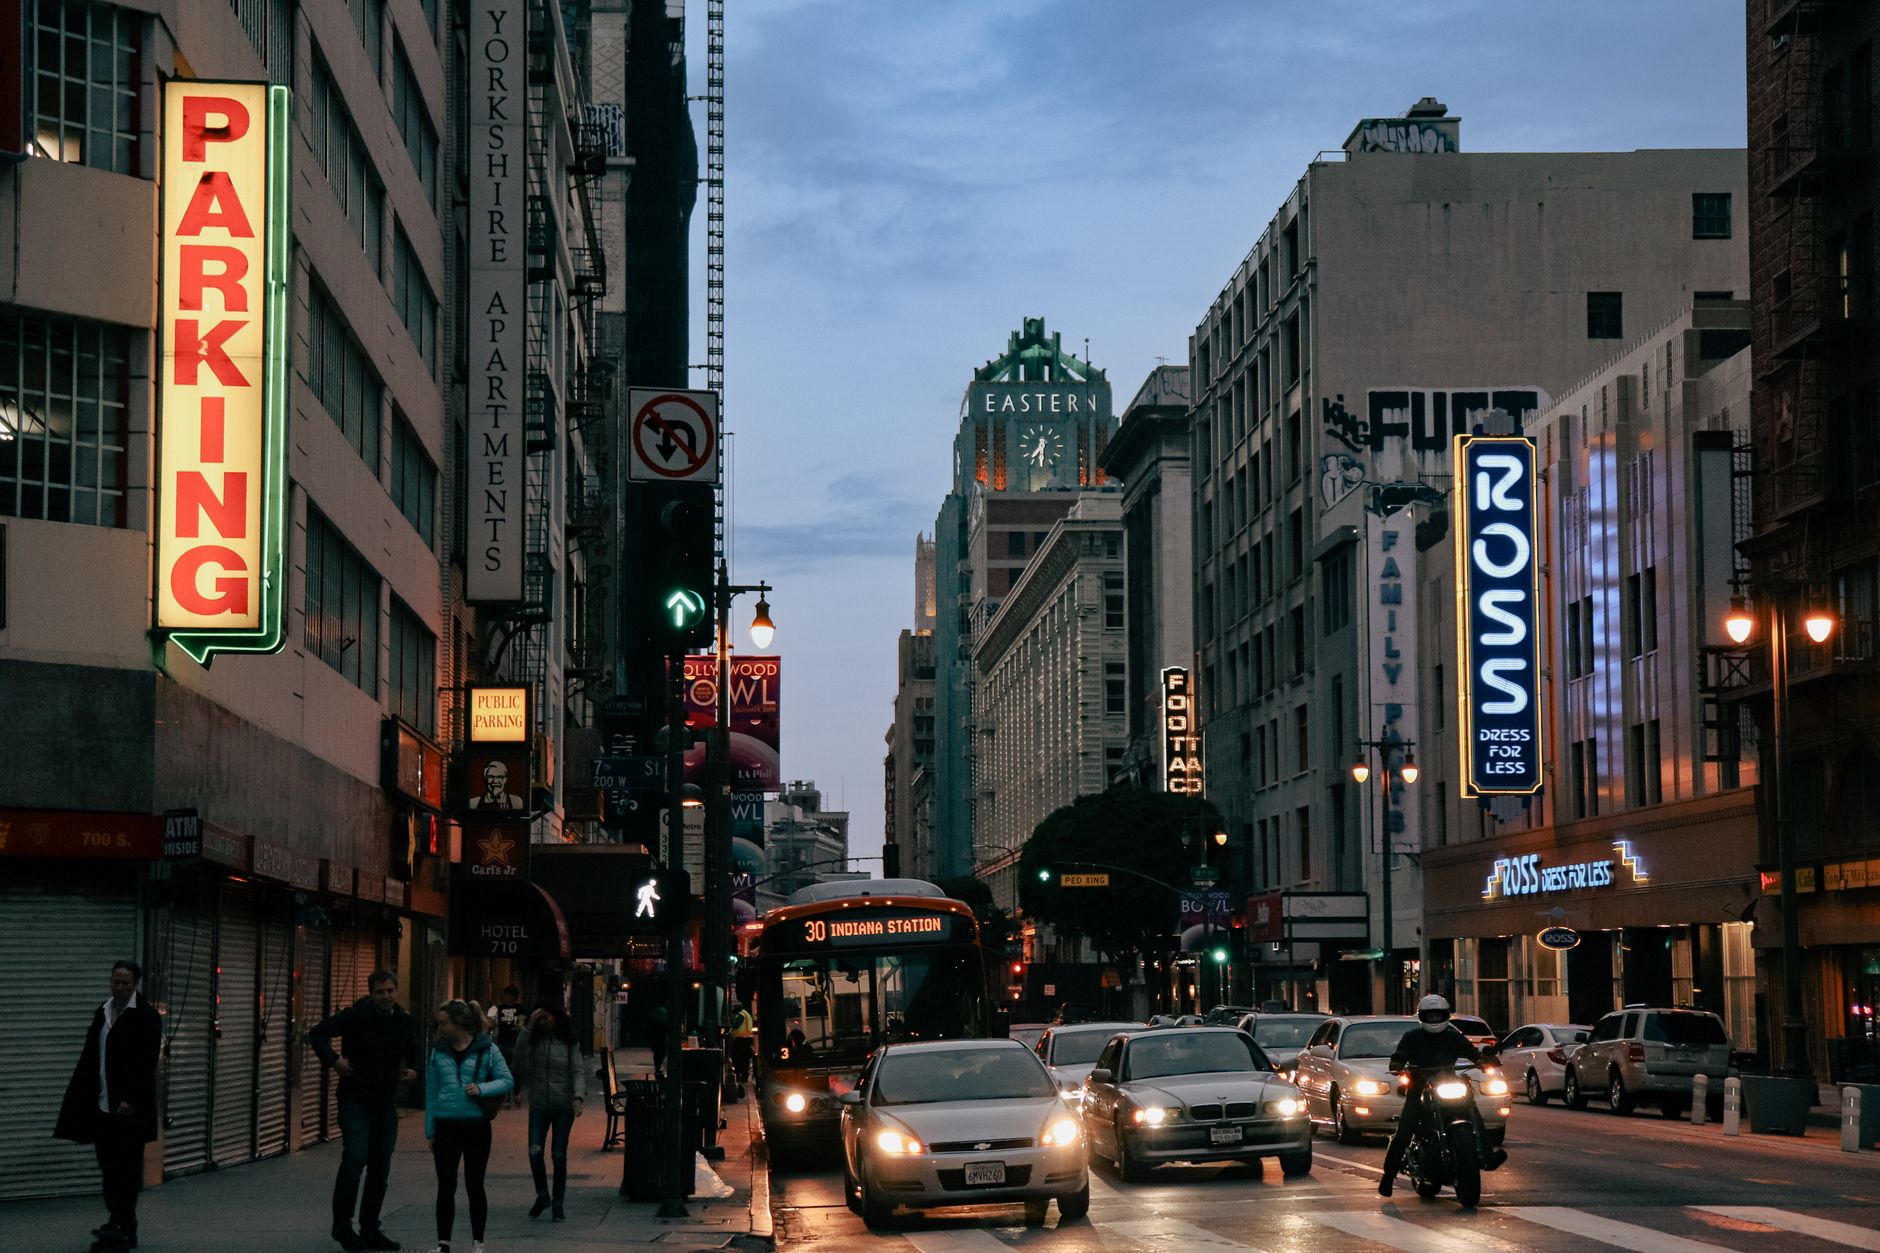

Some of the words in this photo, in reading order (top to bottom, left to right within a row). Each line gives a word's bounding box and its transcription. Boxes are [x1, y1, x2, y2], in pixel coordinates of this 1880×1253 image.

[485, 10, 509, 262] YORKSHIRE
[170, 96, 255, 616] PARKING
[985, 393, 1097, 413] EASTERN
[484, 290, 509, 572] APARTMENTS
[1473, 454, 1531, 715] ROSS
[1380, 529, 1403, 686] FAMILY
[683, 663, 778, 677] OLLYWOOD
[683, 678, 777, 707] OWL
[478, 695, 520, 709] PUBLIC
[476, 714, 523, 729] PARKING
[1480, 728, 1530, 742] DRESS
[1489, 745, 1522, 758] FOR
[644, 759, 661, 776] St
[1485, 761, 1527, 774] LESS
[593, 775, 613, 788] 200
[617, 775, 627, 788] W
[165, 815, 198, 839] ATM
[81, 831, 110, 847] 700
[165, 839, 199, 857] INSIDE
[471, 864, 502, 877] Carl's
[1503, 853, 1539, 896] ROSS
[1541, 865, 1567, 892] DRESS
[1568, 863, 1586, 889] FOR
[1587, 859, 1610, 888] LESS
[1065, 876, 1082, 885] PED
[1085, 876, 1105, 885] XING
[481, 925, 528, 939] HOTEL
[805, 921, 827, 942] 30
[831, 921, 883, 937] INDIANA
[887, 917, 941, 934] STATION
[1545, 933, 1576, 943] ROSS
[490, 941, 518, 954] 710
[781, 1047, 790, 1061] 3
